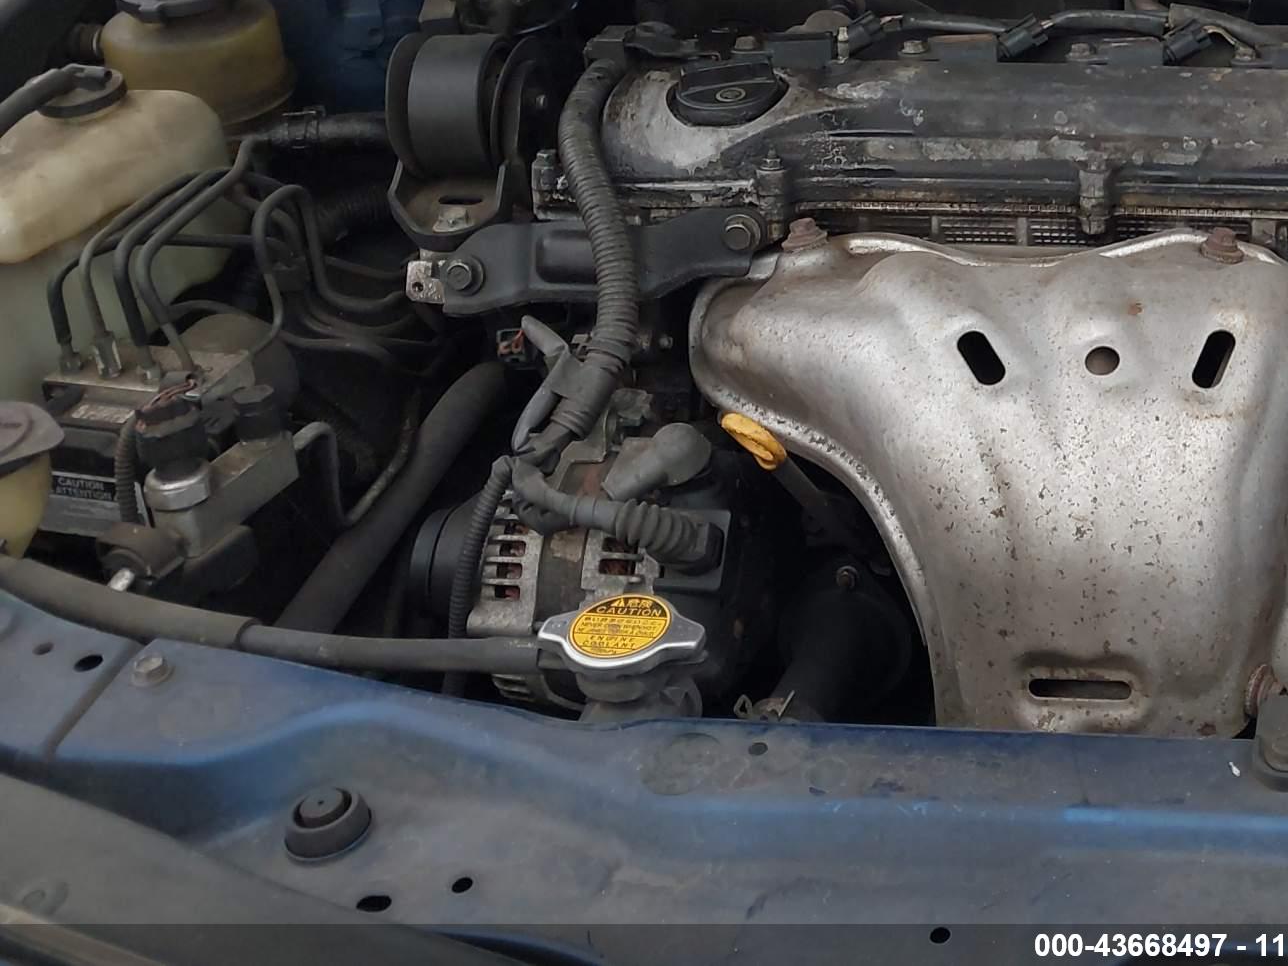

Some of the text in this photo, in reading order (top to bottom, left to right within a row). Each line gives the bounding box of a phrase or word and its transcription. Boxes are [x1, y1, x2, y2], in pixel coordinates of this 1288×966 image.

[57, 476, 105, 490] CAUTION
[55, 487, 113, 501] ATTENTION
[596, 606, 662, 617] CAUTION
[582, 640, 637, 648] COOLANT
